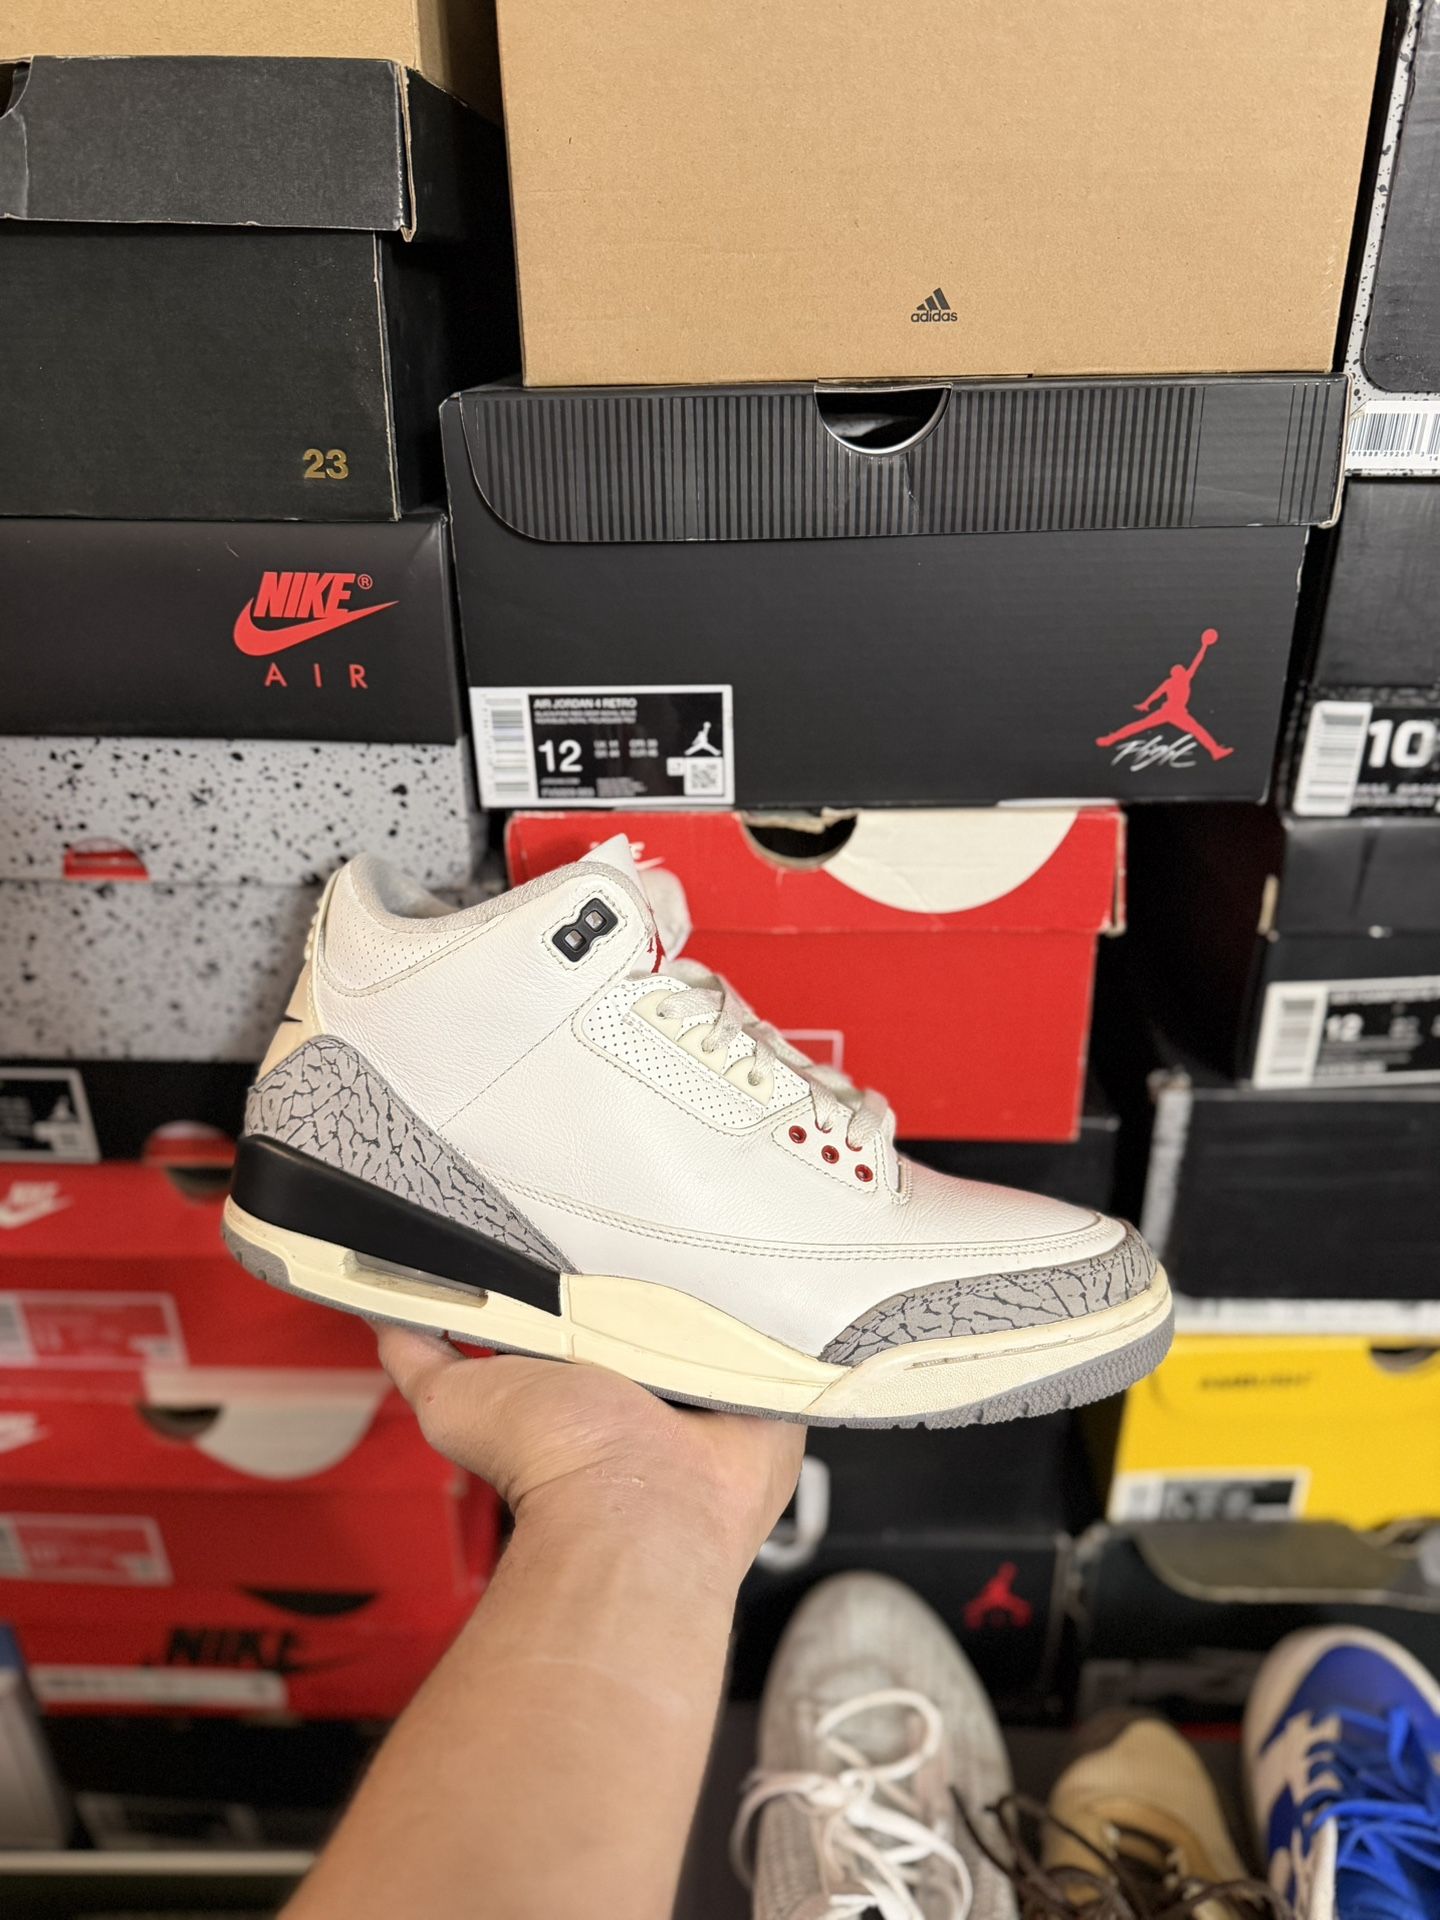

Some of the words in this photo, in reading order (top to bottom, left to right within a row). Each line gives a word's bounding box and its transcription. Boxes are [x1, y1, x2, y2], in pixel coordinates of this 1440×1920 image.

[910, 309, 958, 323] adidas
[302, 448, 349, 480] 23
[553, 697, 594, 710] JORDAN
[603, 697, 638, 709] RETRO
[537, 739, 583, 773] 12
